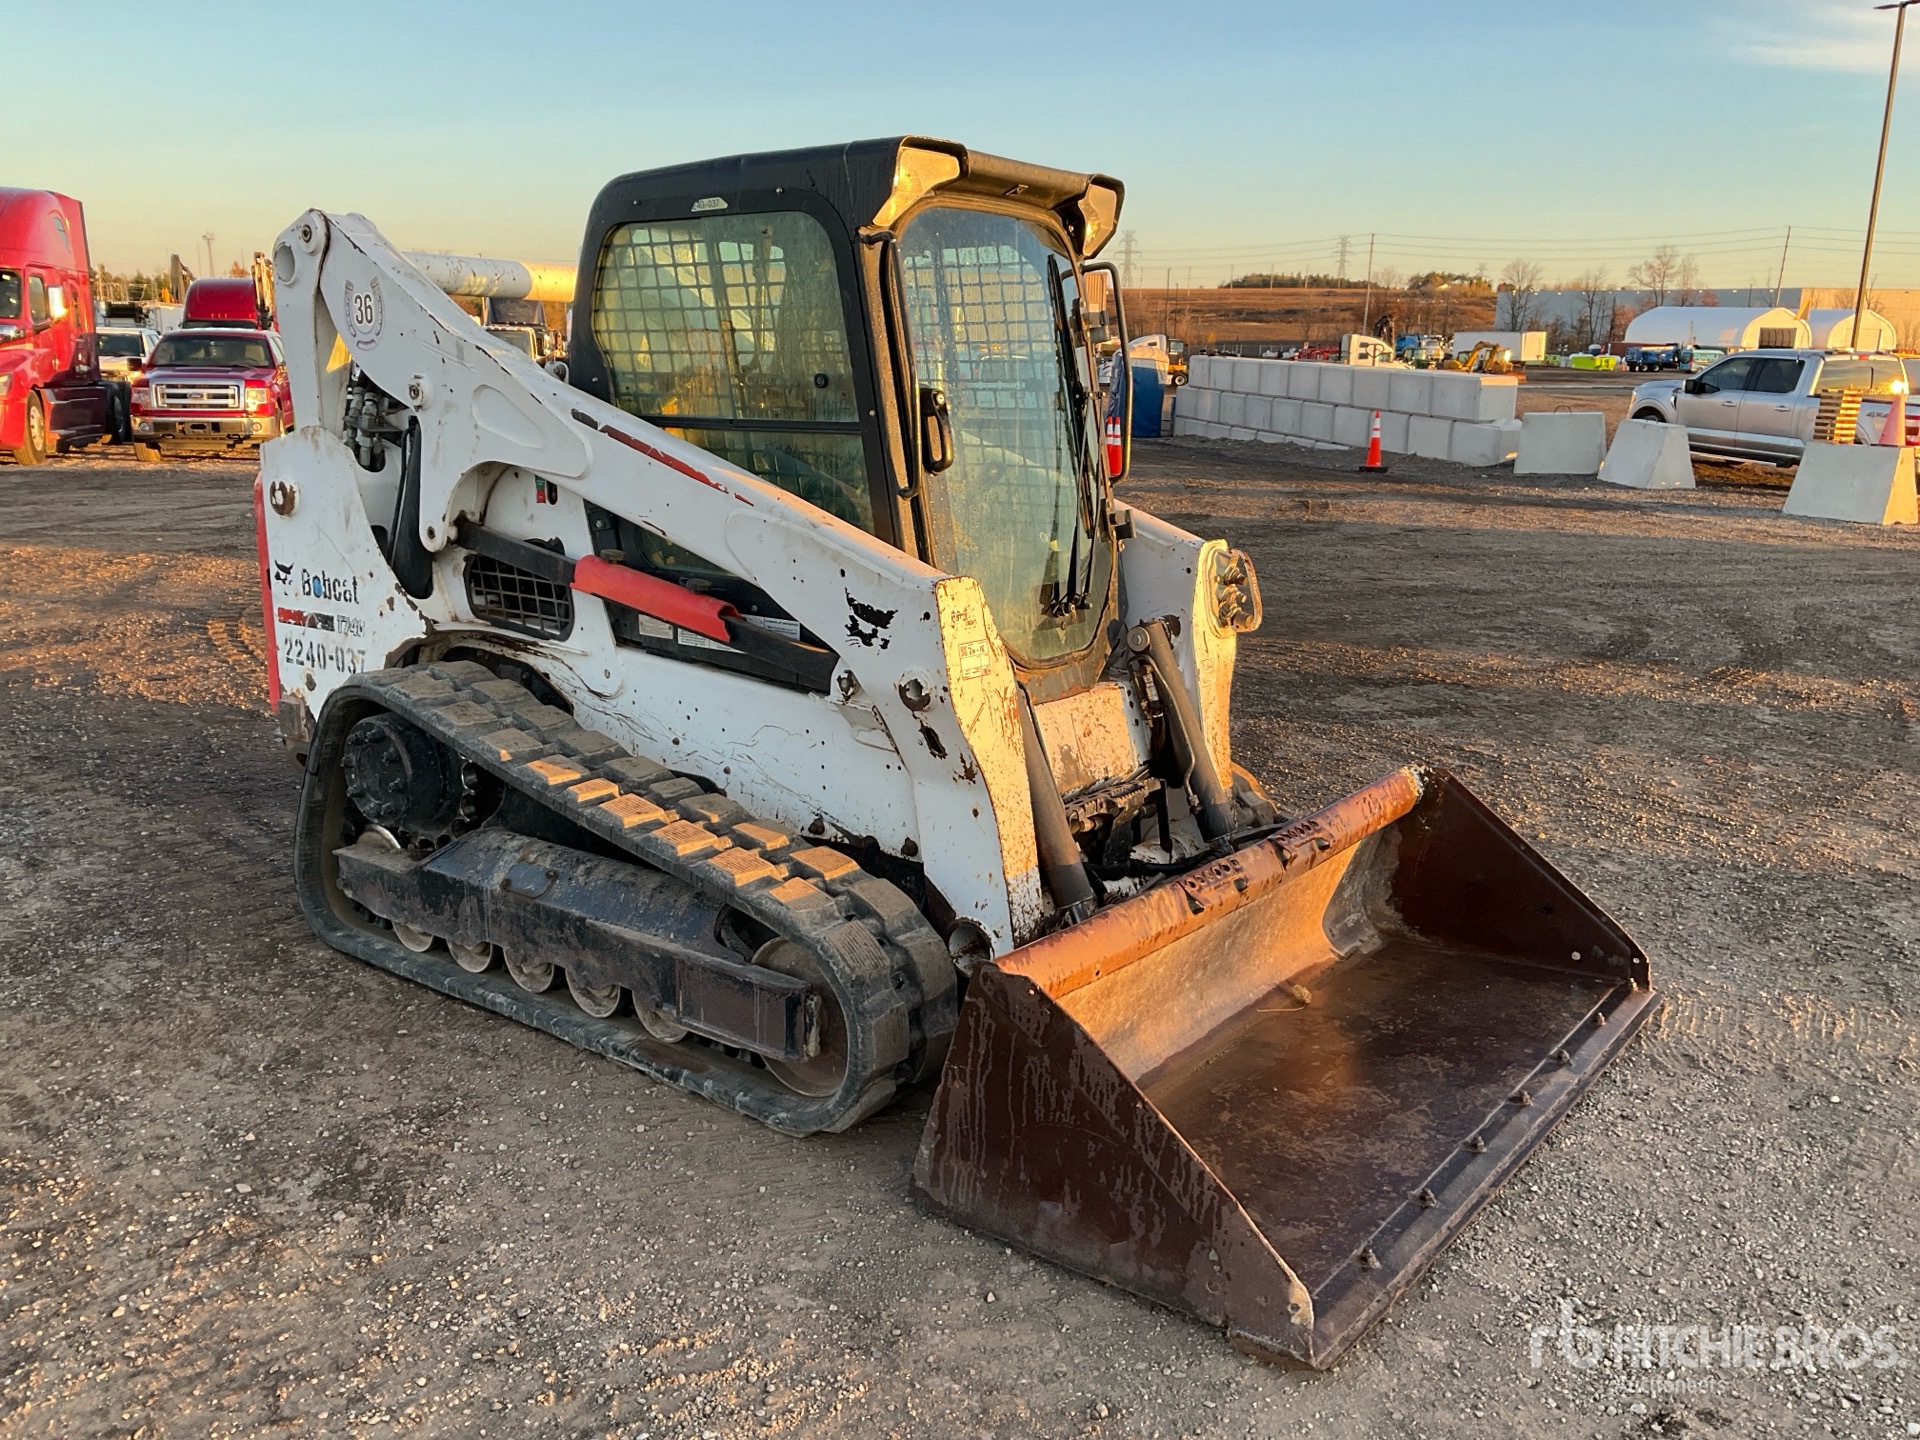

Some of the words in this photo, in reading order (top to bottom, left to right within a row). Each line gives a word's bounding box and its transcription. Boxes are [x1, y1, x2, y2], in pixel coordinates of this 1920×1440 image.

[354, 293, 374, 325] 36
[301, 567, 360, 605] Bobcat
[284, 637, 367, 675] 2240-037
